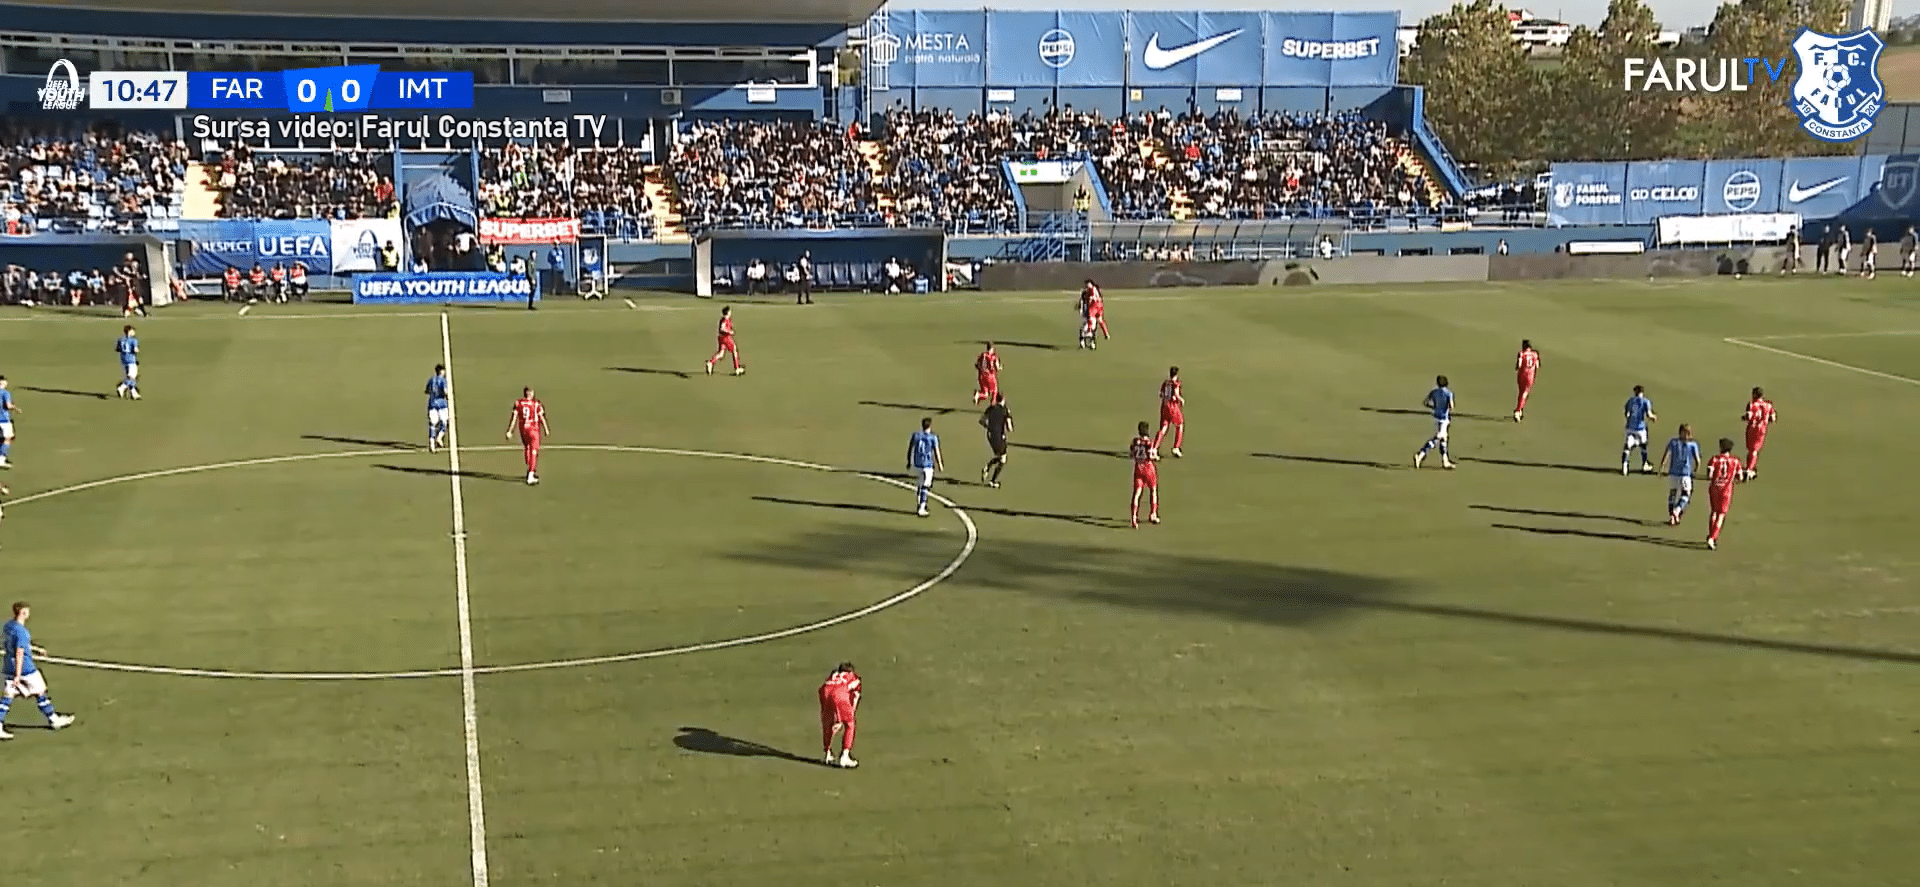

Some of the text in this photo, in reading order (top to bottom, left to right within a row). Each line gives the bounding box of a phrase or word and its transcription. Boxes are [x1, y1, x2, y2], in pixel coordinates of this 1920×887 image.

[905, 33, 969, 50] MESTA
[1282, 36, 1381, 60] SUPERBET
[1651, 185, 1699, 201] CELCO
[259, 235, 328, 256] UEFA
[360, 280, 403, 297] UEFA
[404, 279, 466, 296] YOUTH
